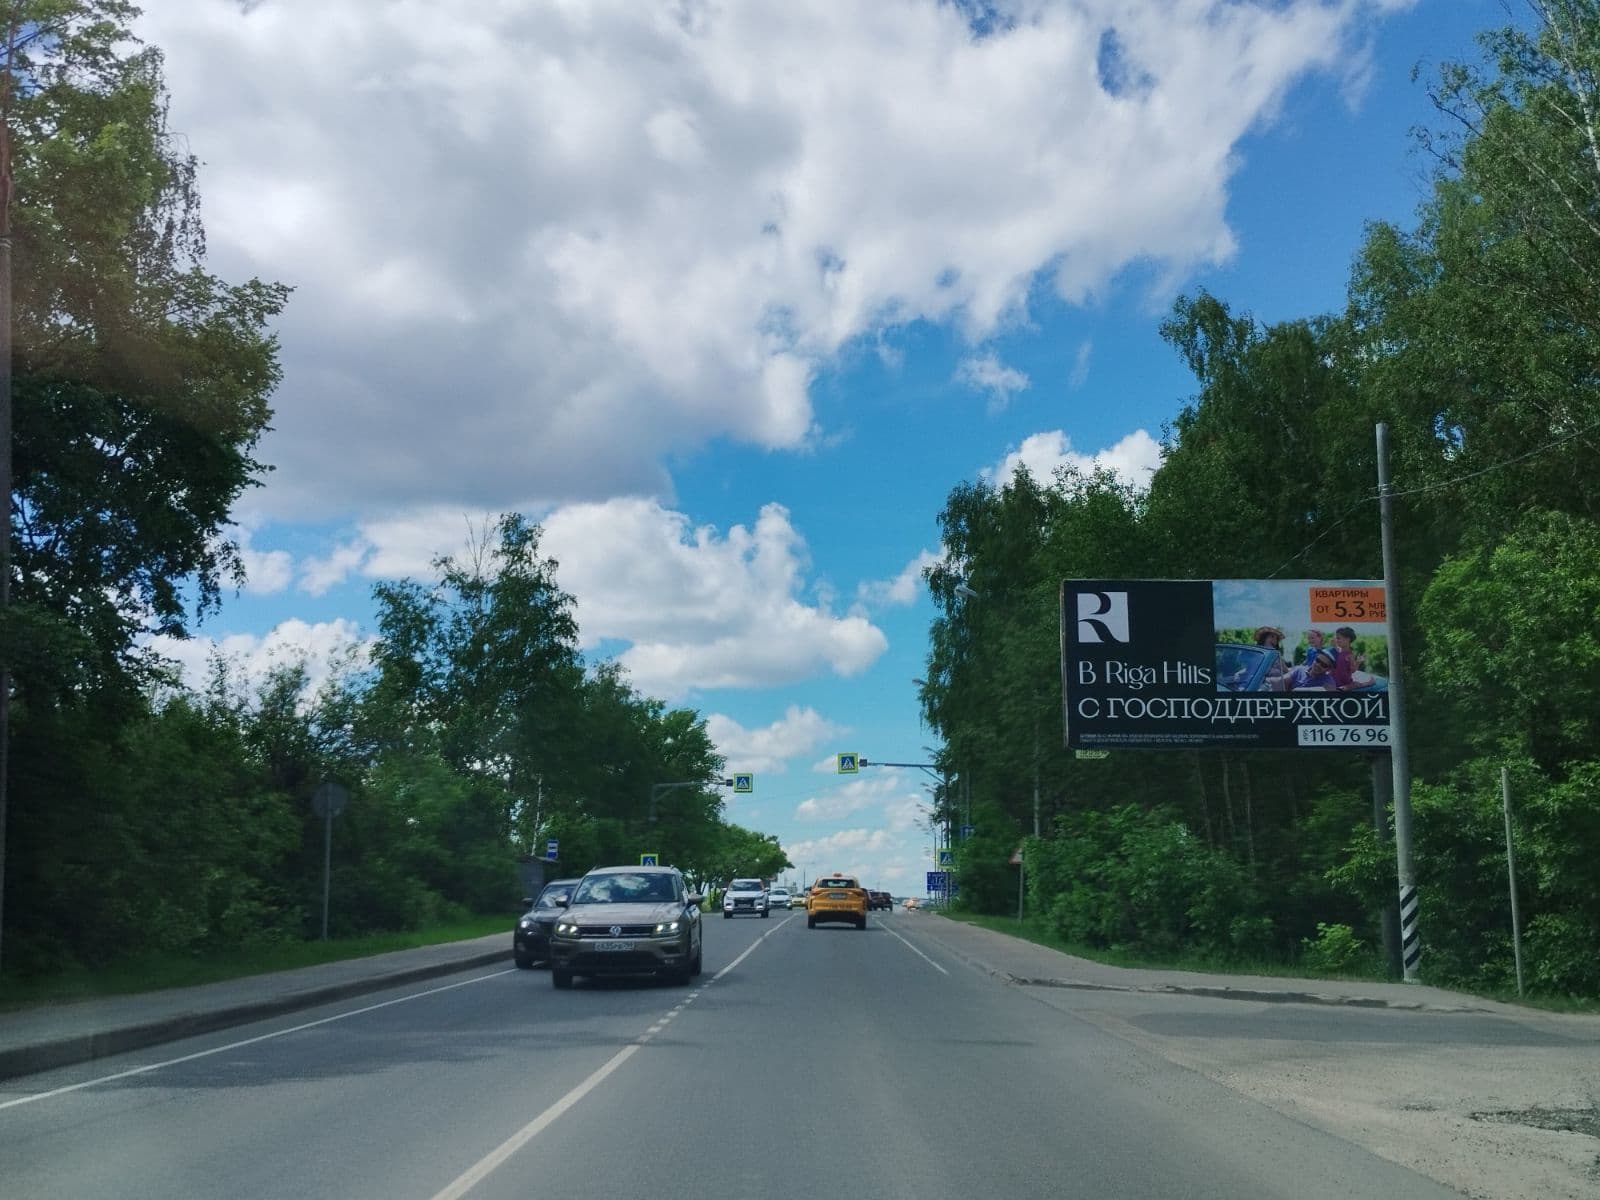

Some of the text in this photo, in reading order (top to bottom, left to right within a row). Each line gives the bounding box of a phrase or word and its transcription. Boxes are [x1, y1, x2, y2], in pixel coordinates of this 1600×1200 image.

[1315, 590, 1369, 598] КВАРТИРЫ
[1316, 600, 1366, 618] ОТ 5.3
[1078, 660, 1212, 690] В Riga Hills
[1106, 693, 1386, 724] ГОСПОДДЕРЖКОЙ
[1310, 728, 1336, 742] 116
[1340, 728, 1361, 742] 76
[1365, 728, 1389, 743] 96
